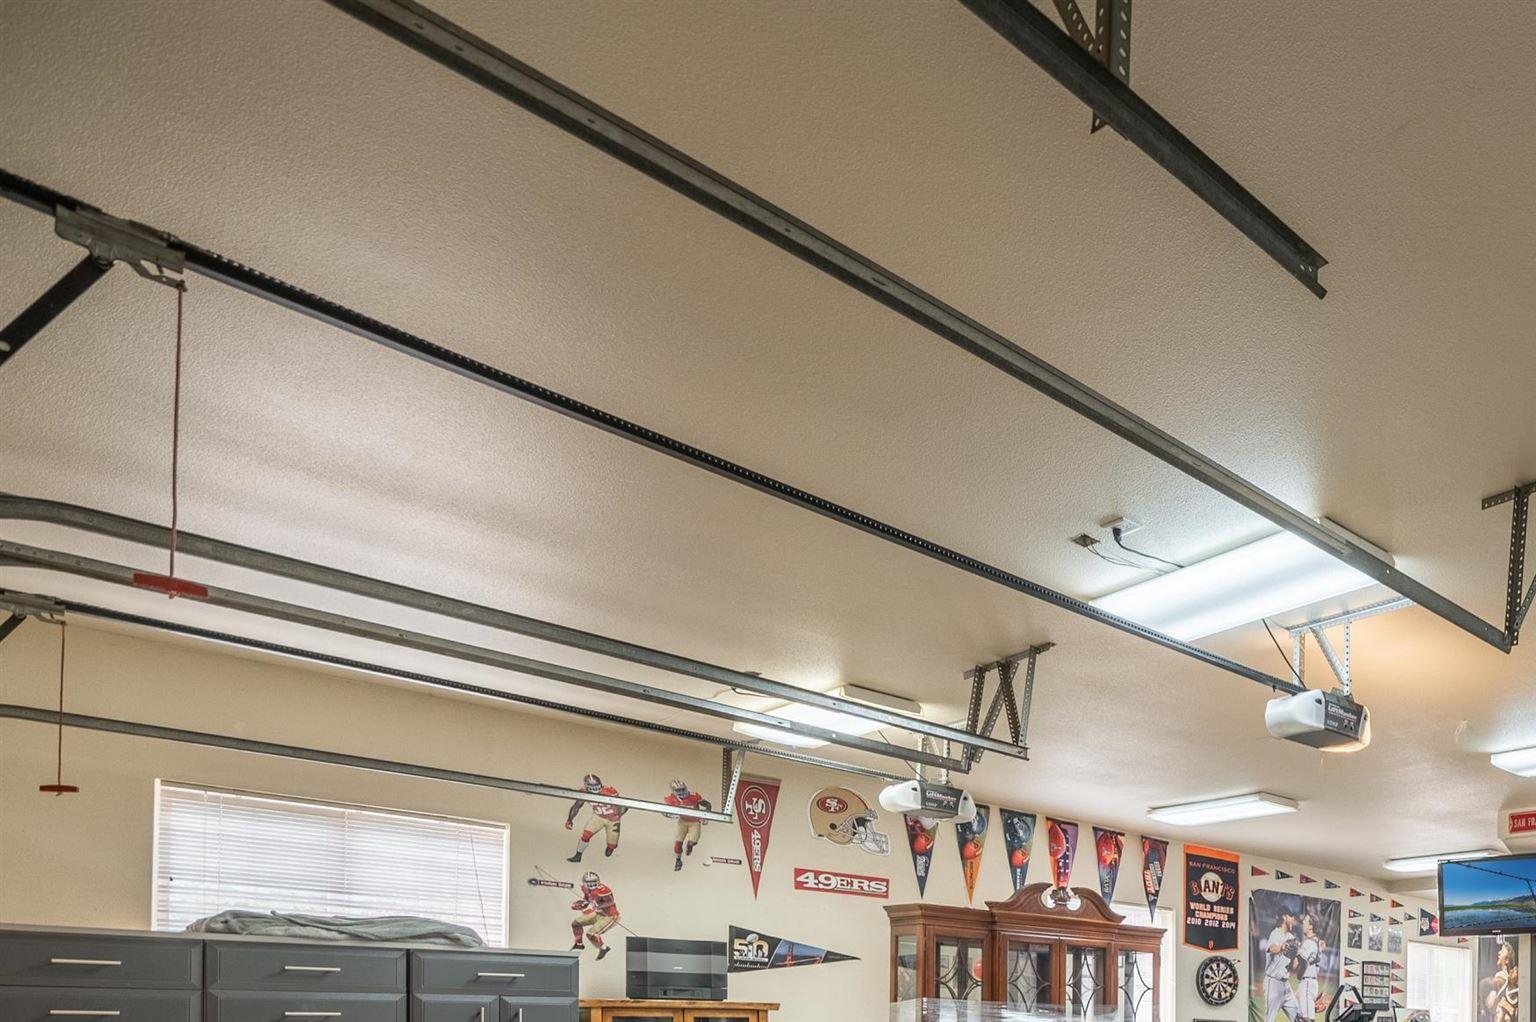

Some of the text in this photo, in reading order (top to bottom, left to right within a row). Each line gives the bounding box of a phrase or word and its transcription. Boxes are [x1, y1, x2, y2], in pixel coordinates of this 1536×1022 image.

[1514, 818, 1526, 828] SAN
[751, 829, 762, 873] 49ERS
[796, 871, 888, 893] 49ERS
[1190, 902, 1234, 914] WORLD SERIES
[1186, 916, 1236, 929] 2010 2012 2014
[1195, 910, 1228, 922] CHAMPIONS
[733, 938, 770, 960] 50
